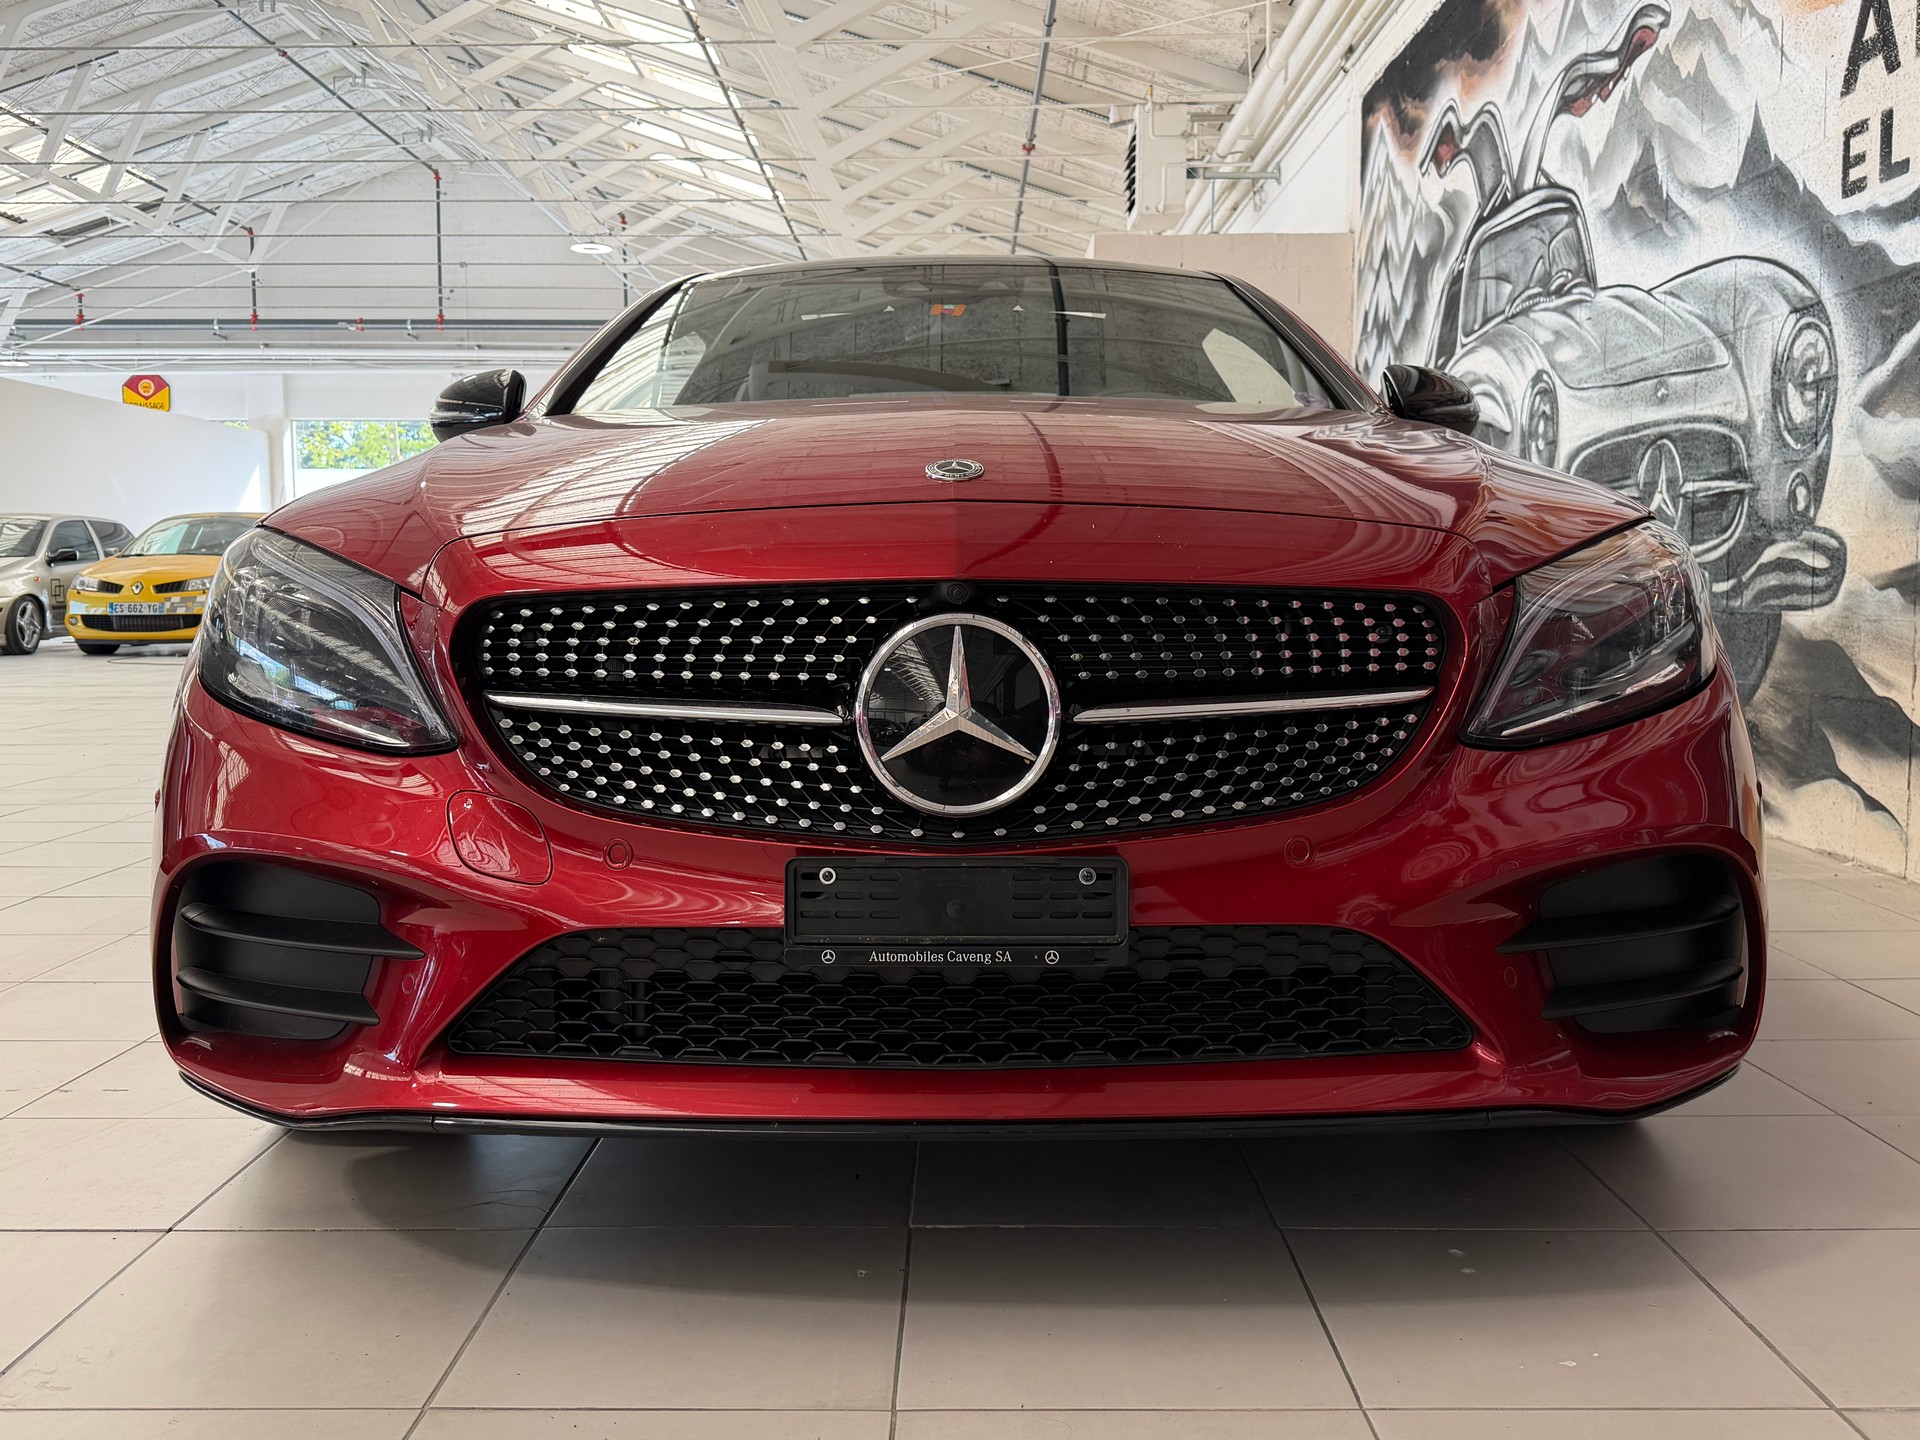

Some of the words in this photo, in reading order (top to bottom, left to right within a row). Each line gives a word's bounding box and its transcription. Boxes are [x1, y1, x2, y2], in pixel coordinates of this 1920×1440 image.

[1840, 0, 1920, 99] A
[1841, 106, 1910, 199] EL
[868, 950, 944, 963] Automobiles
[947, 950, 992, 965] Caveng
[995, 950, 1013, 963] SA
